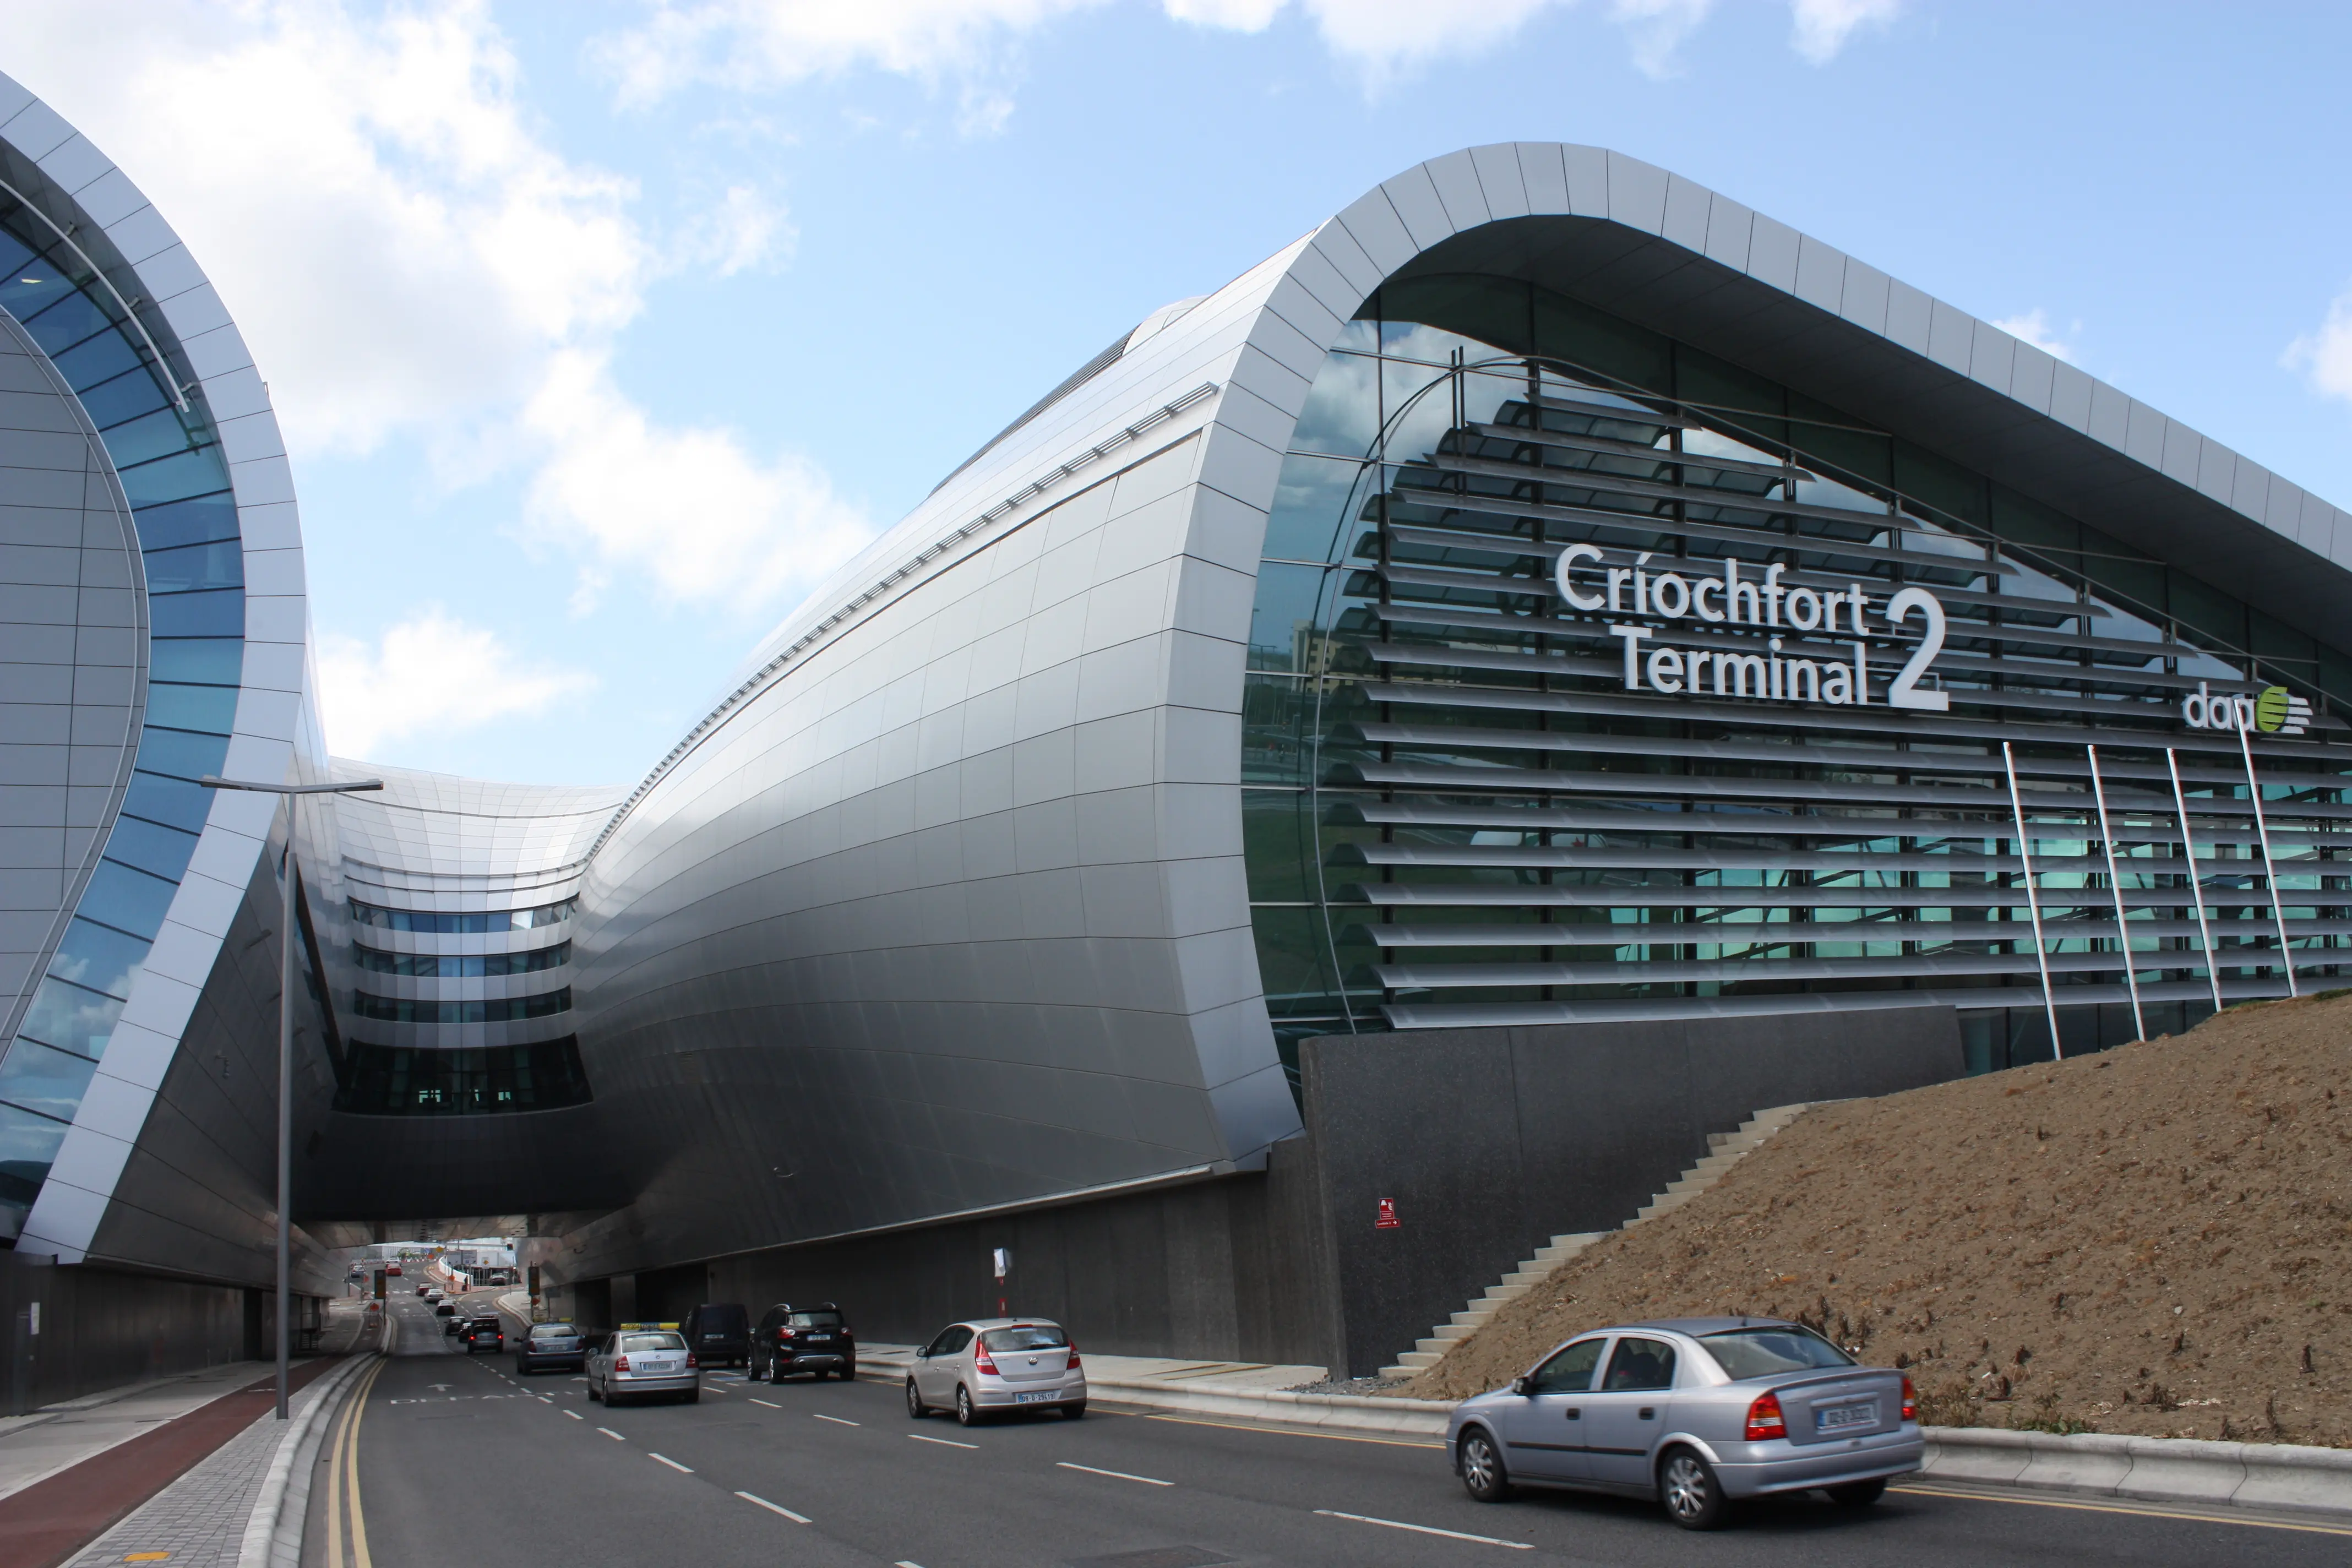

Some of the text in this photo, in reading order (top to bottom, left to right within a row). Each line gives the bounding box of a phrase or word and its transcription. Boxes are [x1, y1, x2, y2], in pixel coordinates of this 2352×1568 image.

[1555, 543, 1870, 636] Críochfort
[1609, 587, 1950, 712] Terminal 2
